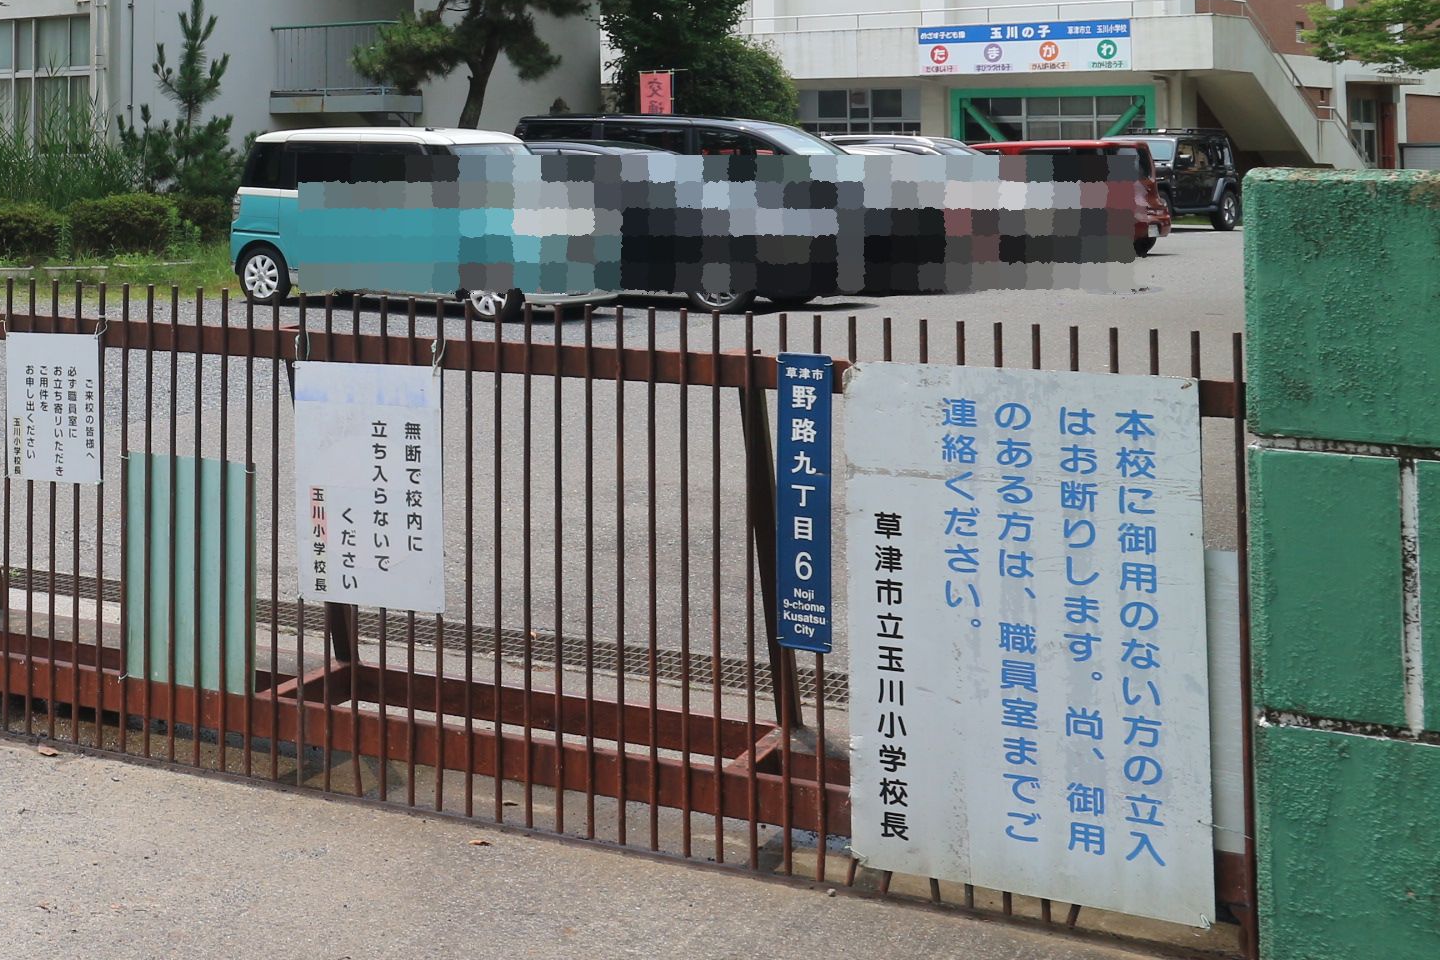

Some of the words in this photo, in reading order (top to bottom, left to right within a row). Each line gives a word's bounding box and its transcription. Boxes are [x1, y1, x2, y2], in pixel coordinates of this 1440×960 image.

[933, 48, 946, 61] た
[987, 47, 1000, 60] ま
[990, 24, 1051, 40] 玉川の子
[1042, 44, 1056, 58] が
[1066, 25, 1092, 35] 草津市立
[1096, 24, 1128, 34] 玉川小学校
[1101, 43, 1114, 57] わ
[39, 365, 48, 412] ご用件を
[67, 366, 78, 438] 必ず職員室に
[785, 366, 824, 381] 草津市
[25, 365, 36, 460] お申し出ください
[53, 366, 64, 477] お立ち寄りいただき
[85, 379, 95, 460] ご来校の皆様へ
[13, 417, 22, 475] 玉川小学校長
[371, 420, 390, 572] 立ち入らないで
[404, 422, 424, 552] 無断で校内に
[941, 397, 982, 630] 連絡ください。
[312, 488, 328, 592] 玉川小学校長
[341, 507, 358, 590] ください
[783, 599, 826, 613] 9-chome
[783, 610, 826, 625] Kusatsu
[793, 587, 815, 602] Noji
[994, 401, 1042, 843] のある方は、職員室までご
[794, 623, 816, 638] City
[1059, 406, 1106, 856] はお断りします。尚、御用
[1115, 409, 1166, 868] 本校に御用のない方の立入
[873, 511, 910, 842] 草津市立玉川小学校長
